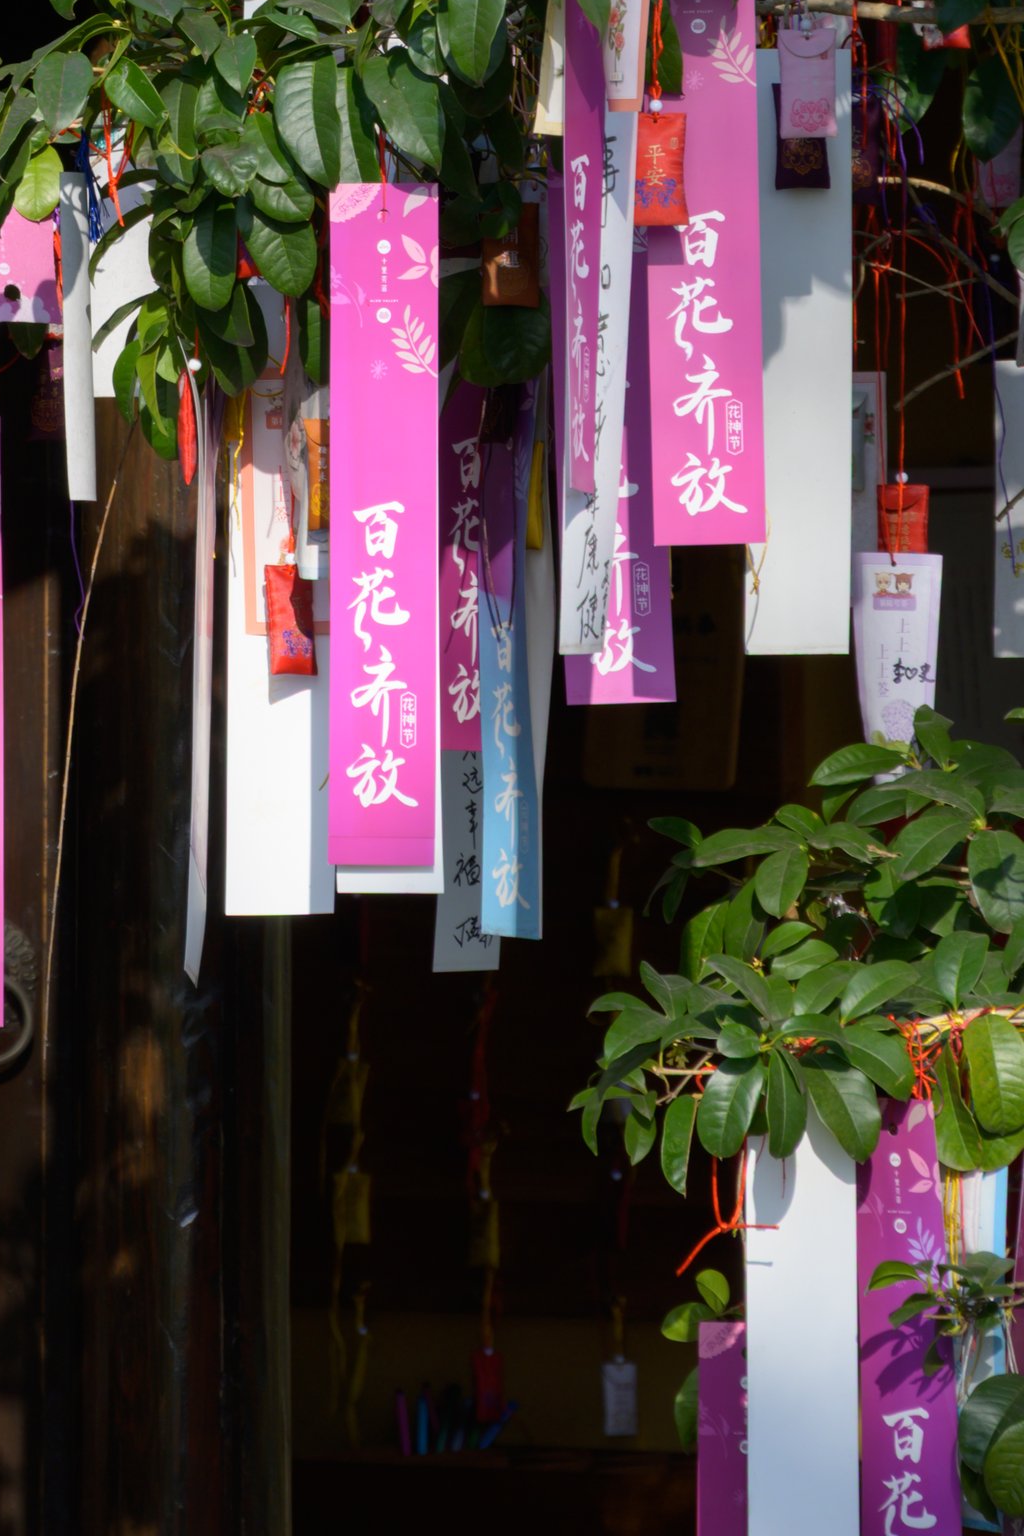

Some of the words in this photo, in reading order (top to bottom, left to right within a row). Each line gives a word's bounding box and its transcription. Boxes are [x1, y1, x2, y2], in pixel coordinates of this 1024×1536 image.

[644, 144, 666, 186] 平安
[570, 154, 590, 462] 百花齐放
[667, 210, 748, 517] 百花齐放
[728, 405, 742, 450] 花神节
[346, 501, 419, 808] 百花齐放
[448, 437, 482, 724] 百花齐放
[635, 567, 649, 612] 花神节
[402, 697, 416, 744] 花神节
[491, 621, 530, 911] 百花齐放
[878, 1407, 937, 1536] 百花
